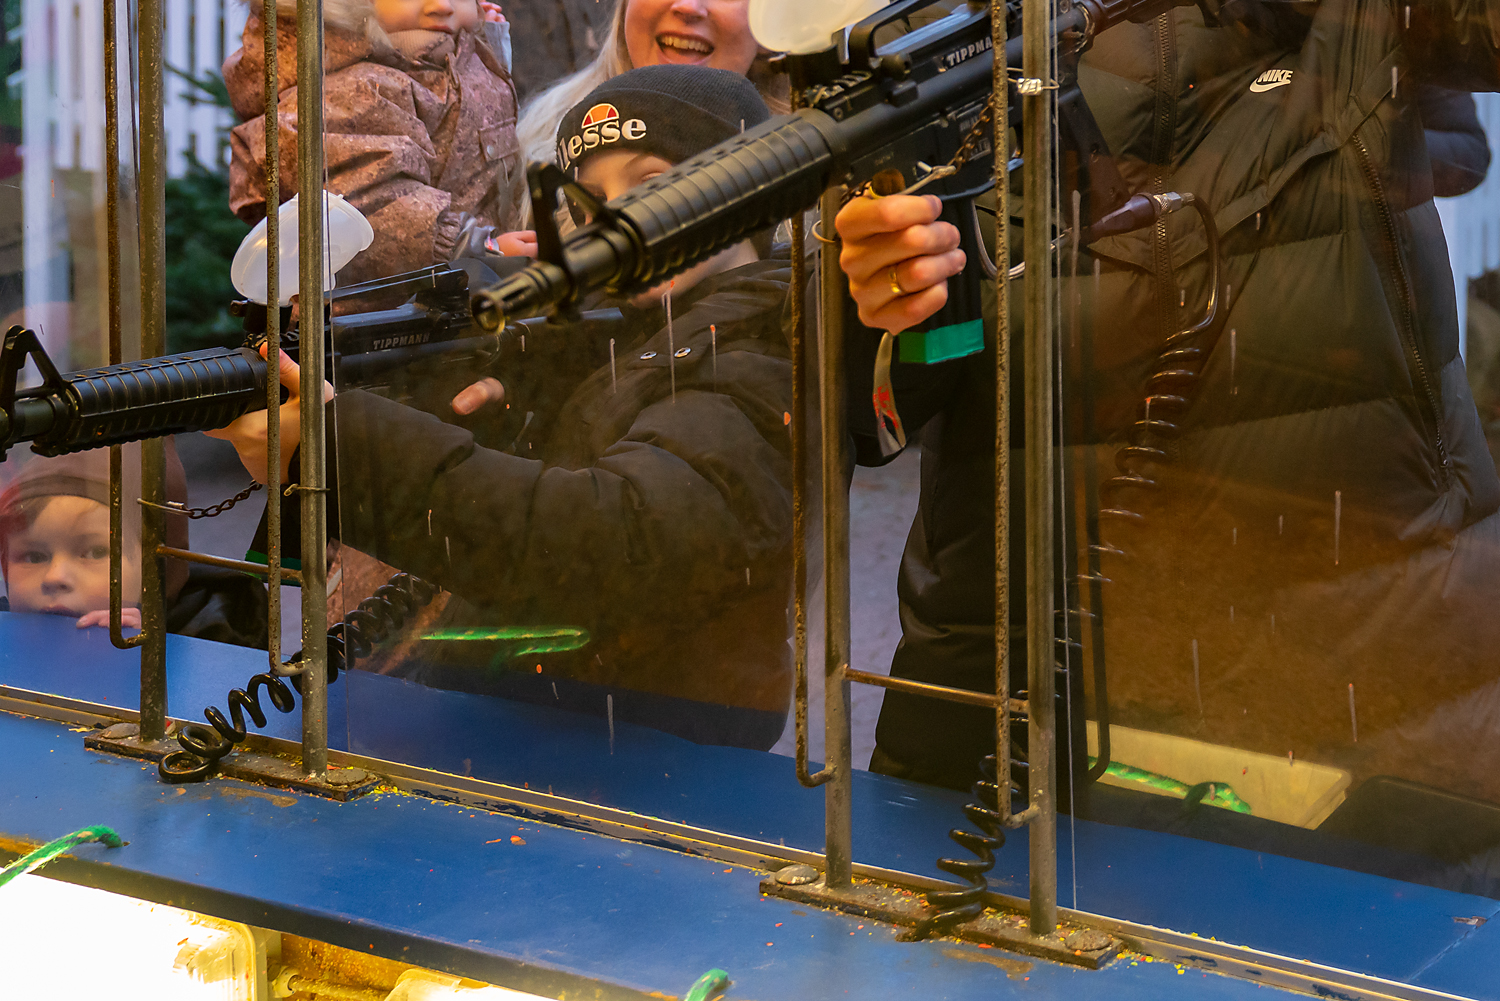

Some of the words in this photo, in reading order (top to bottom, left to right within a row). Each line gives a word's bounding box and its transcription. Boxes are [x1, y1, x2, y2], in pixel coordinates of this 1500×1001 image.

[946, 33, 1005, 67] TIPPMA
[1257, 69, 1294, 83] NIKE
[373, 332, 431, 350] TIPPMANN
